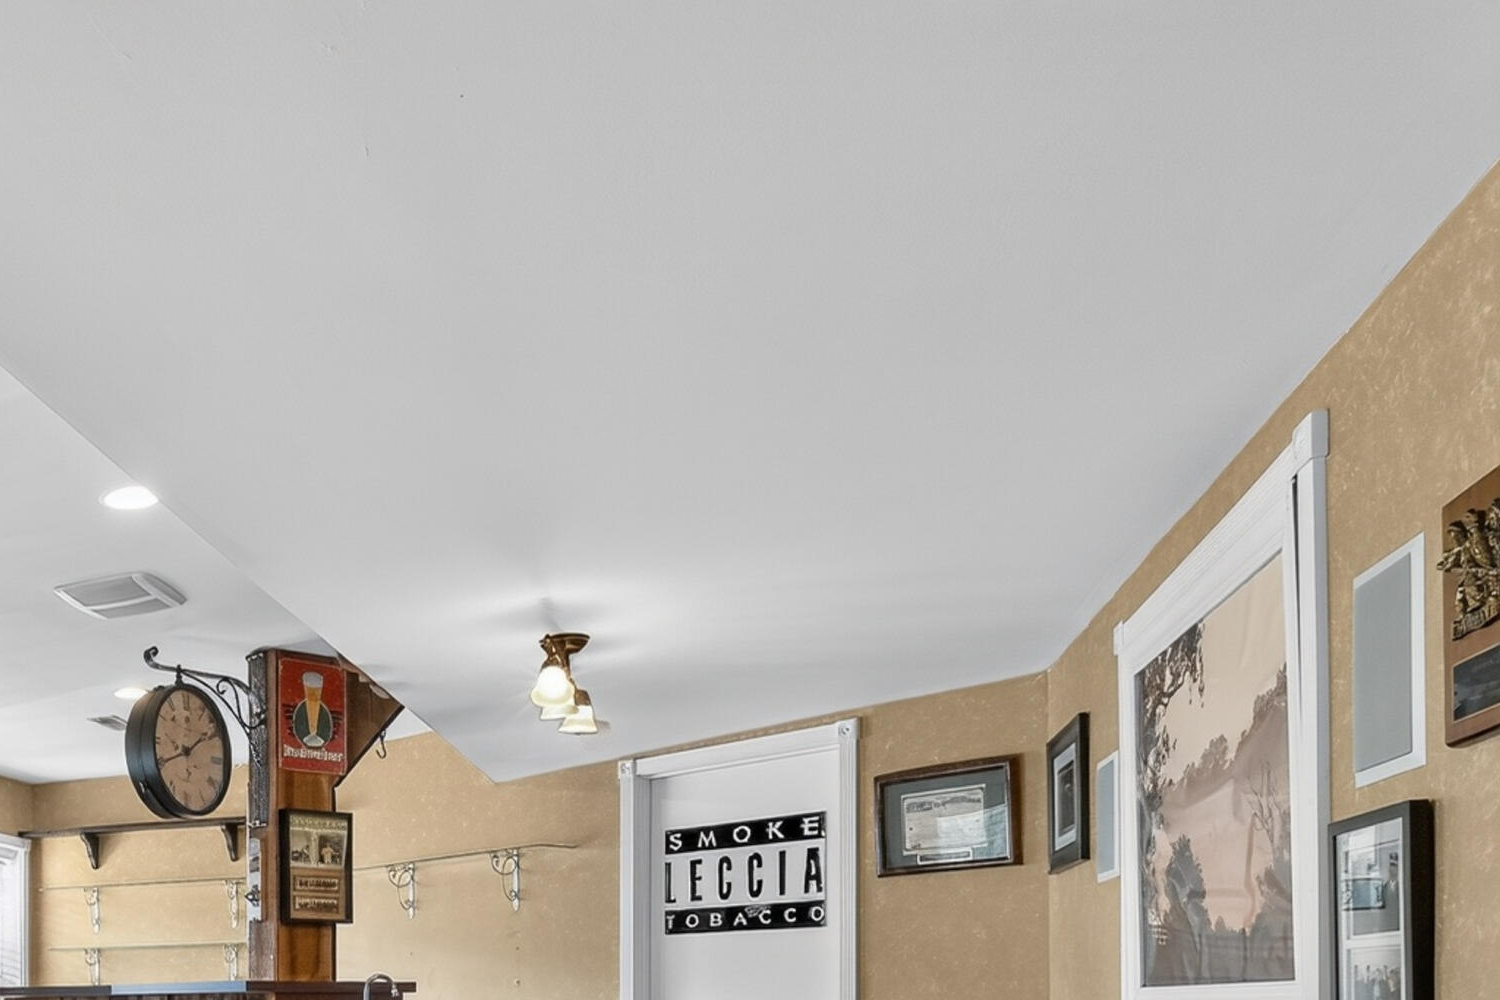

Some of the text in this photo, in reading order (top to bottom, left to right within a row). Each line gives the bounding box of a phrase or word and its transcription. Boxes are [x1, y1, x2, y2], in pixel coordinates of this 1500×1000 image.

[668, 816, 820, 851] SMOKE
[665, 847, 823, 904] LECCIA
[666, 906, 825, 930] TOBACCO
